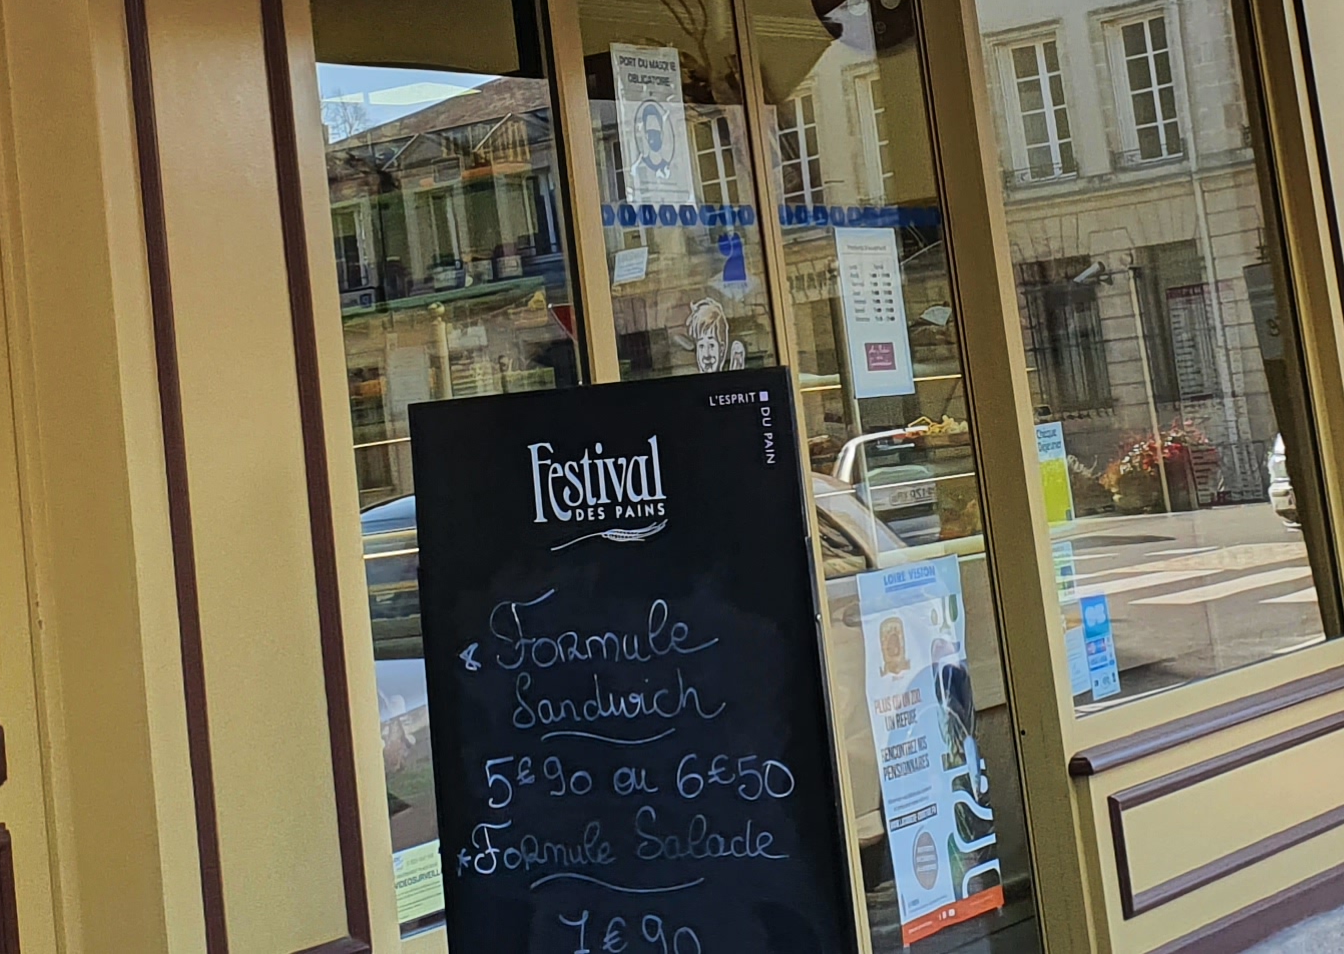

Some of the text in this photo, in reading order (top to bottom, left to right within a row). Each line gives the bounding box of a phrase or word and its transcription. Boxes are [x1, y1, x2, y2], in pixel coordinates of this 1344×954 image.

[709, 392, 756, 406] L'ESPRIT
[760, 406, 776, 464] DU PAIN
[527, 434, 667, 523] Festival
[576, 502, 666, 521] DES PAINS
[512, 668, 726, 729] Sandwich
[613, 765, 659, 795] ou
[634, 804, 790, 863] Salade
